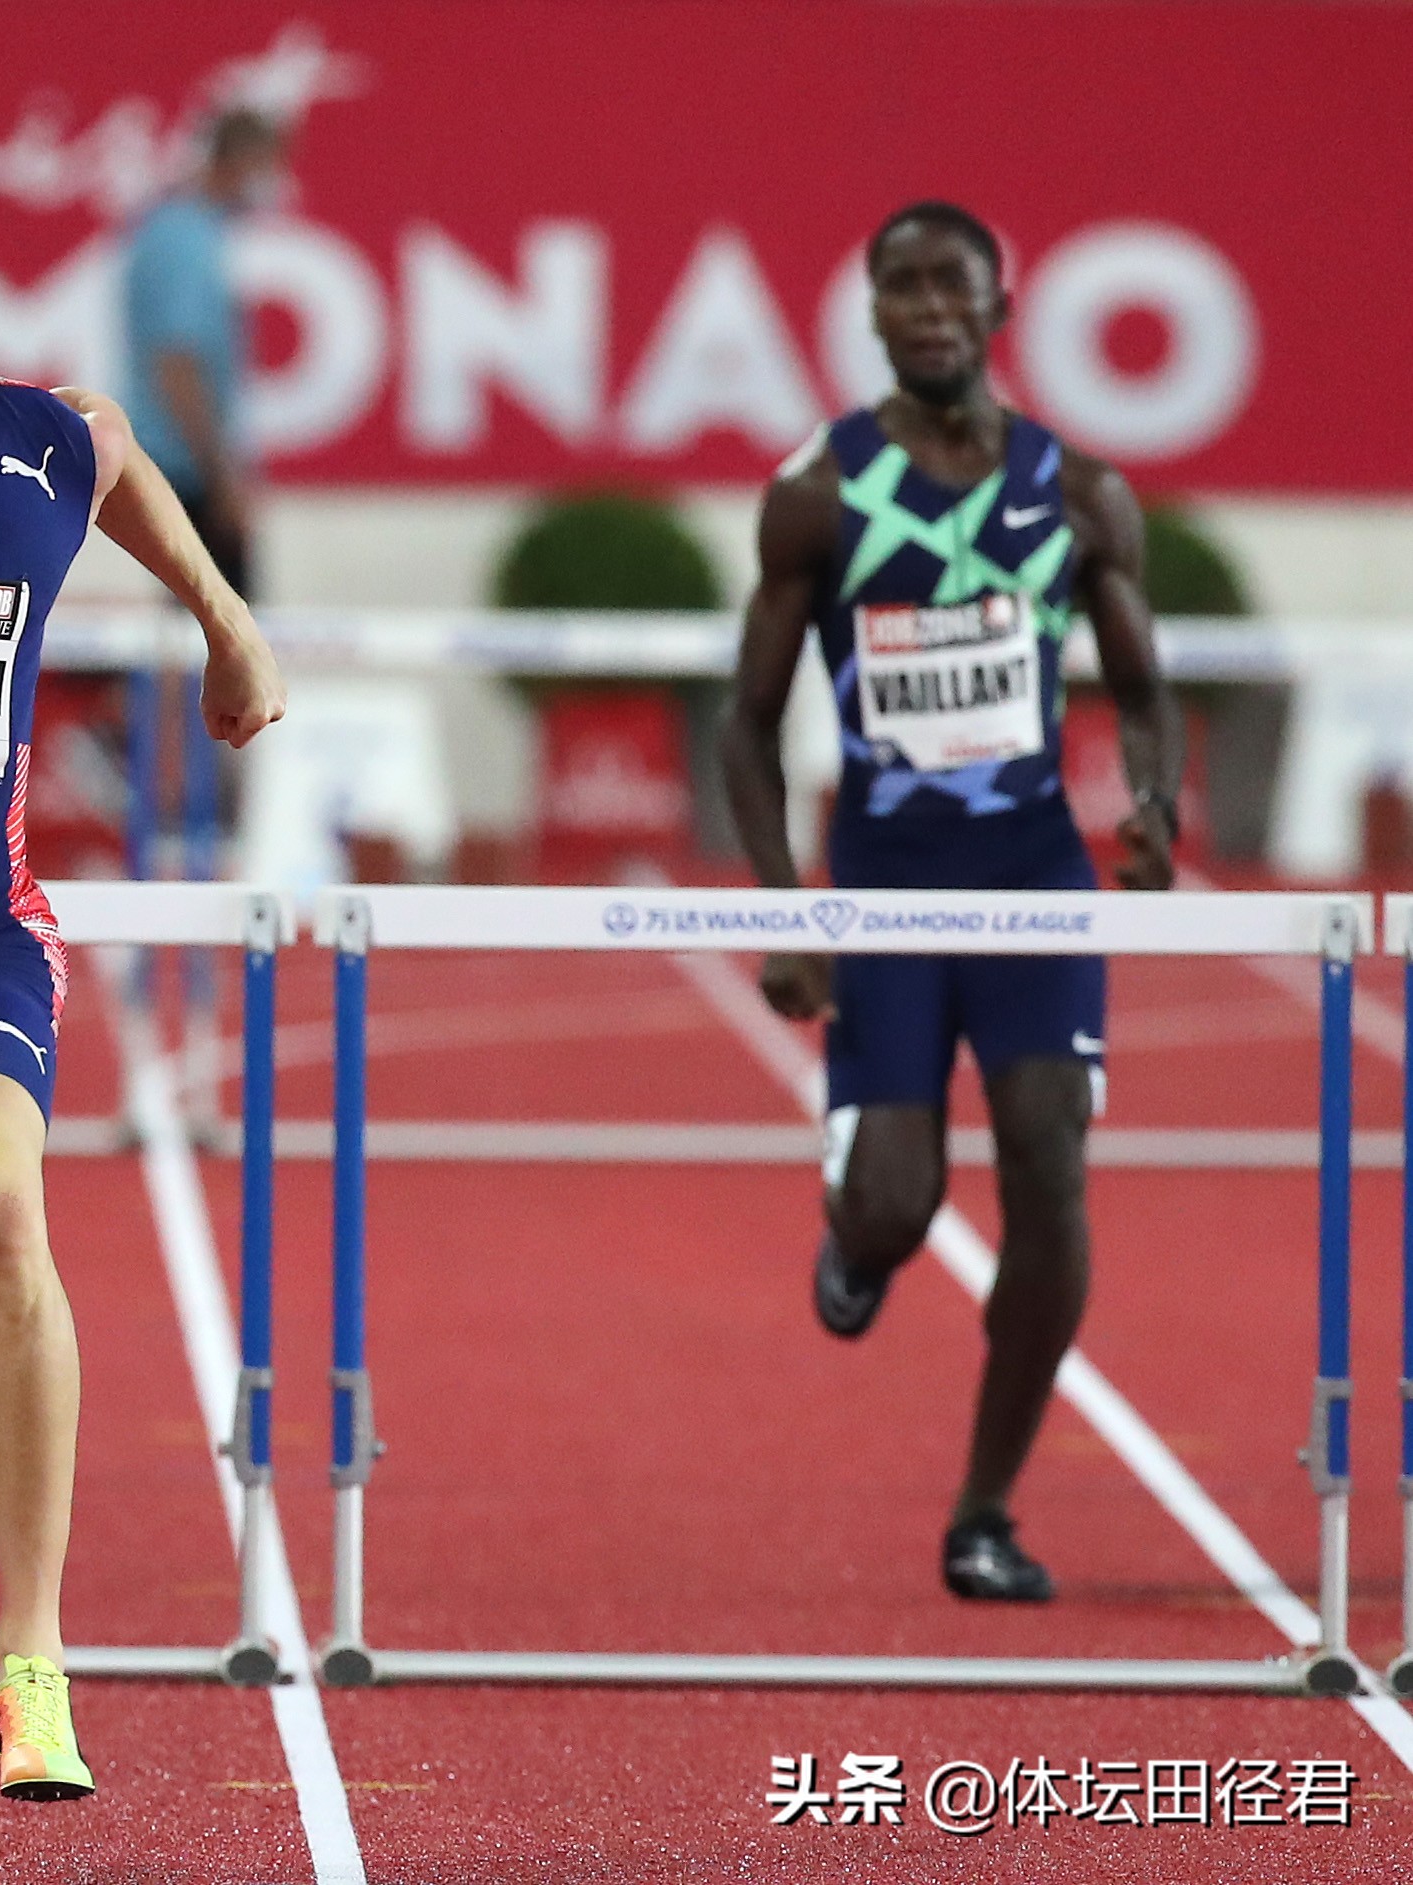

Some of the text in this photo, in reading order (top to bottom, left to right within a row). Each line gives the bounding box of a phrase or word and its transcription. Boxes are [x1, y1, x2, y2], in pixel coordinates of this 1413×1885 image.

[870, 656, 1029, 717] VAILLANT
[862, 911, 984, 933] DIAMOND
[991, 911, 1092, 934] LEAGUE
